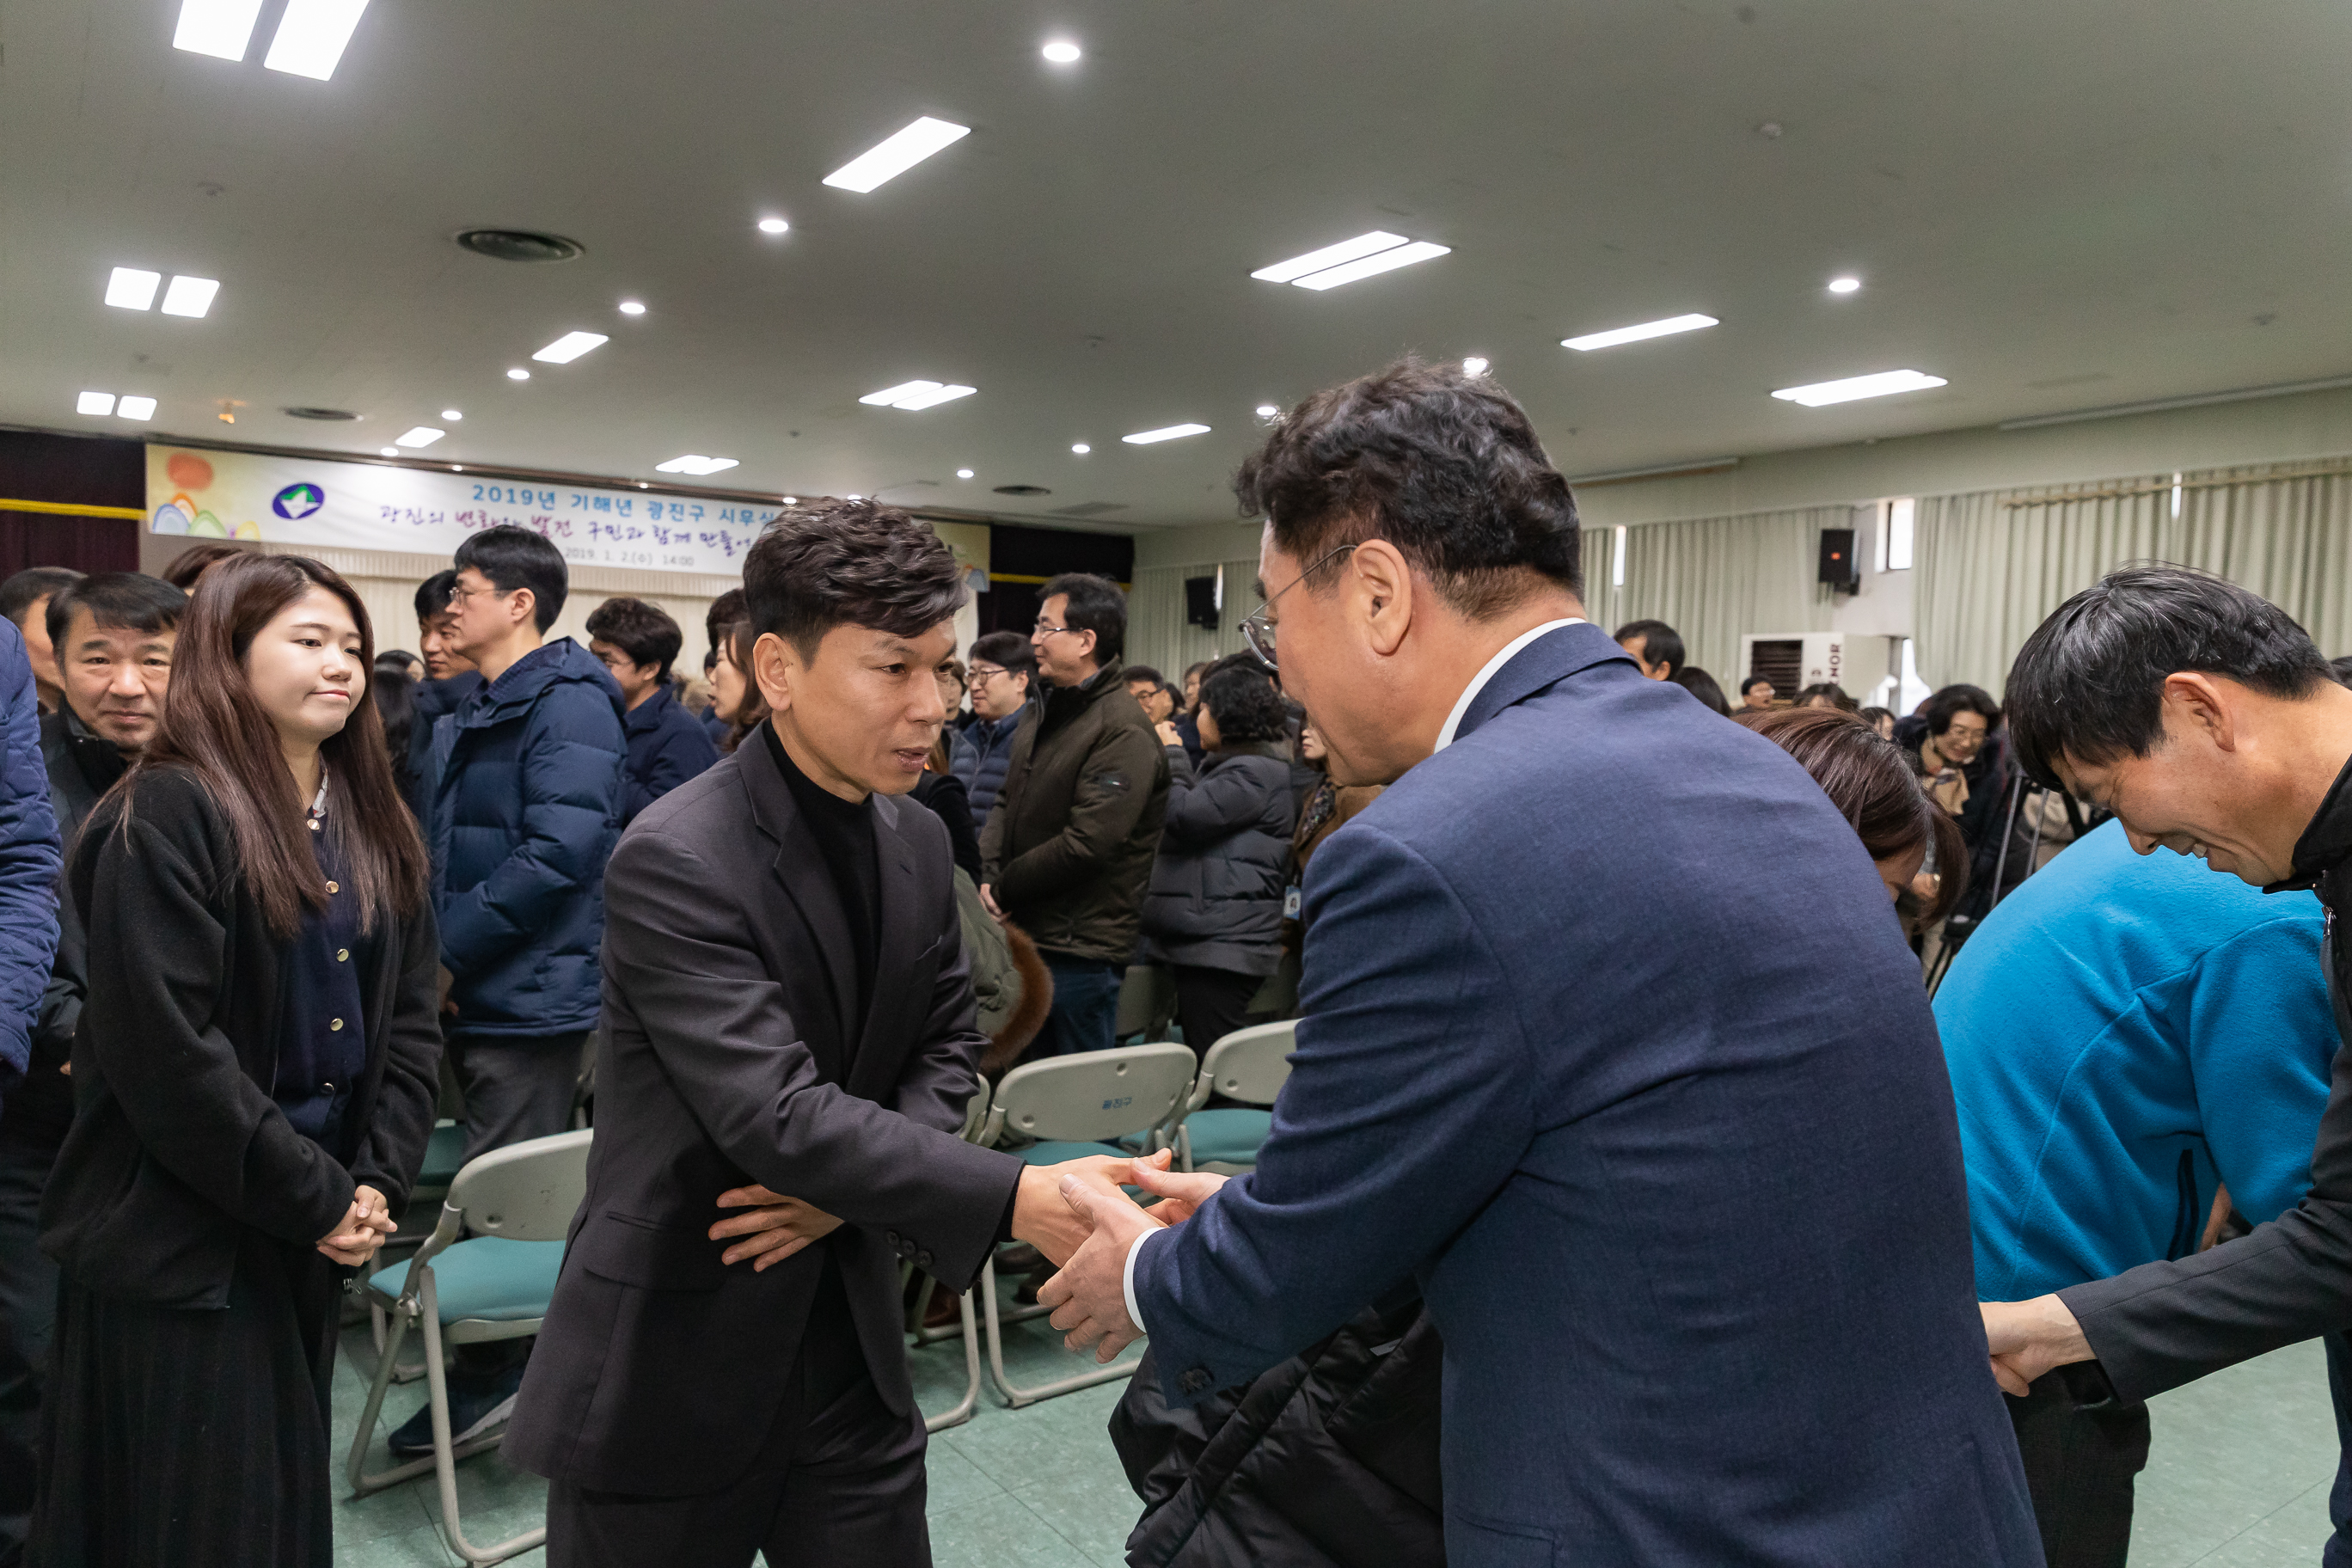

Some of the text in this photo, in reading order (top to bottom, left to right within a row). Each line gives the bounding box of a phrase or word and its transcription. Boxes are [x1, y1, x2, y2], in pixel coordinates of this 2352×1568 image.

[473, 484, 555, 511] 2019년
[571, 493, 633, 518] 기해년
[647, 500, 705, 523] 광진구
[380, 505, 444, 525] 광진의
[588, 520, 646, 542] 구민과
[652, 524, 691, 545] 함께
